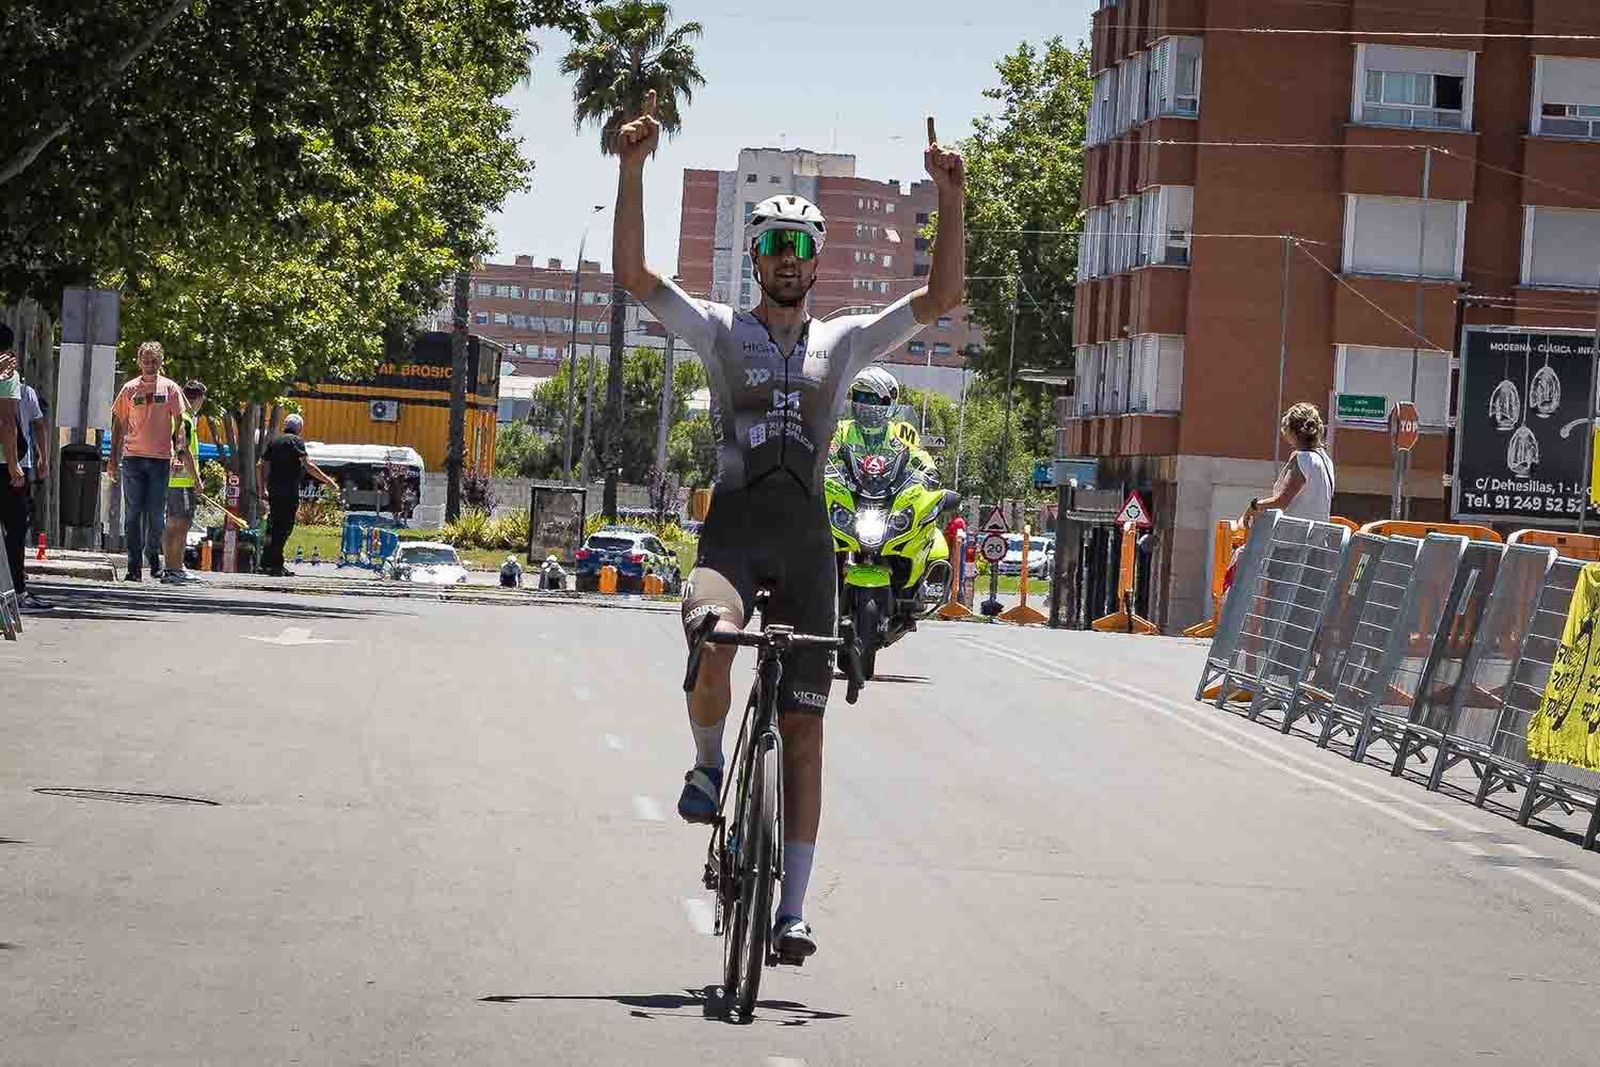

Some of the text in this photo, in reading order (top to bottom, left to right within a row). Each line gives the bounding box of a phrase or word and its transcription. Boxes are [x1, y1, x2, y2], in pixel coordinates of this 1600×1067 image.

[1490, 342, 1531, 352] MODERNA
[1475, 477, 1489, 490] C/
[1491, 479, 1555, 494] Dehesillas,
[1465, 493, 1491, 508] Tel.
[1495, 495, 1510, 509] 91
[1513, 497, 1541, 510] 249
[1545, 498, 1563, 512] 52
[987, 543, 1003, 554] 20
